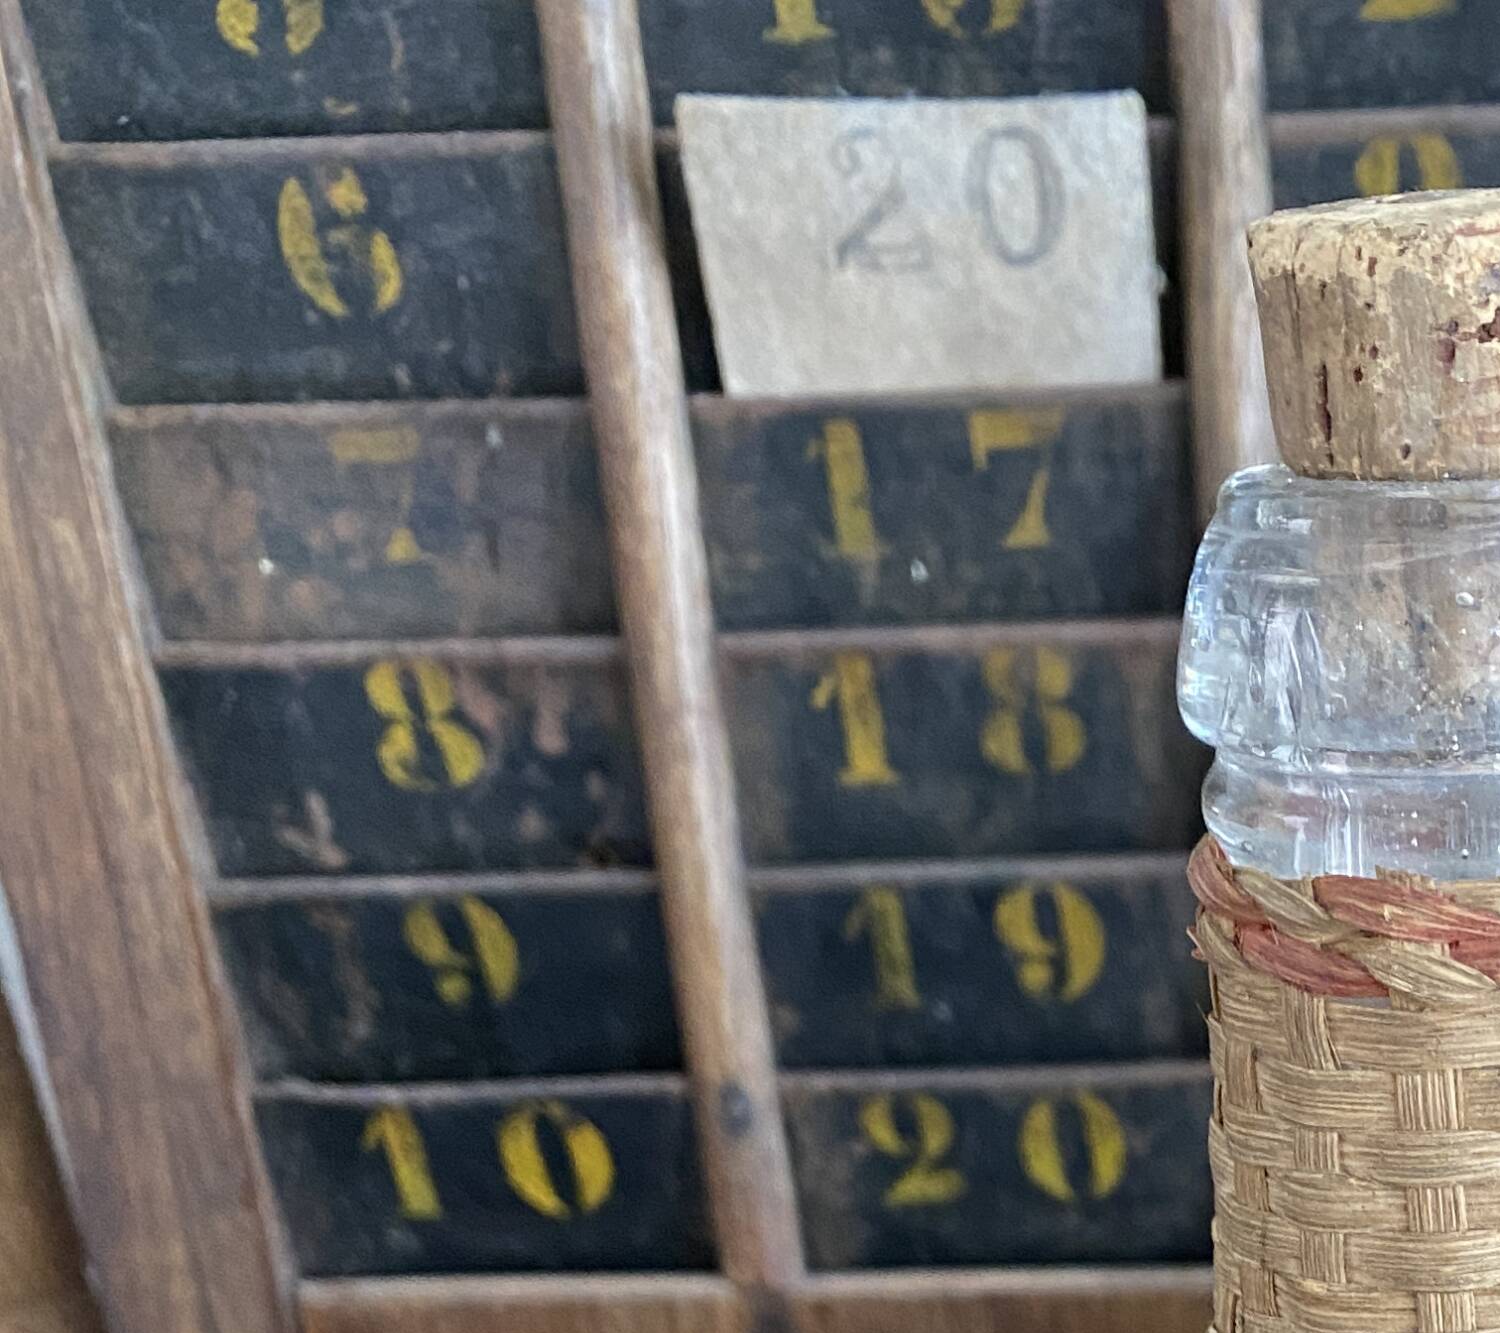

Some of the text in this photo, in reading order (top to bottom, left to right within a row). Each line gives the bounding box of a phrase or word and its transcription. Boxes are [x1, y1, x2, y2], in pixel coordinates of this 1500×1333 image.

[277, 163, 402, 318] 6
[362, 657, 489, 791] 8
[405, 893, 520, 1003] 9
